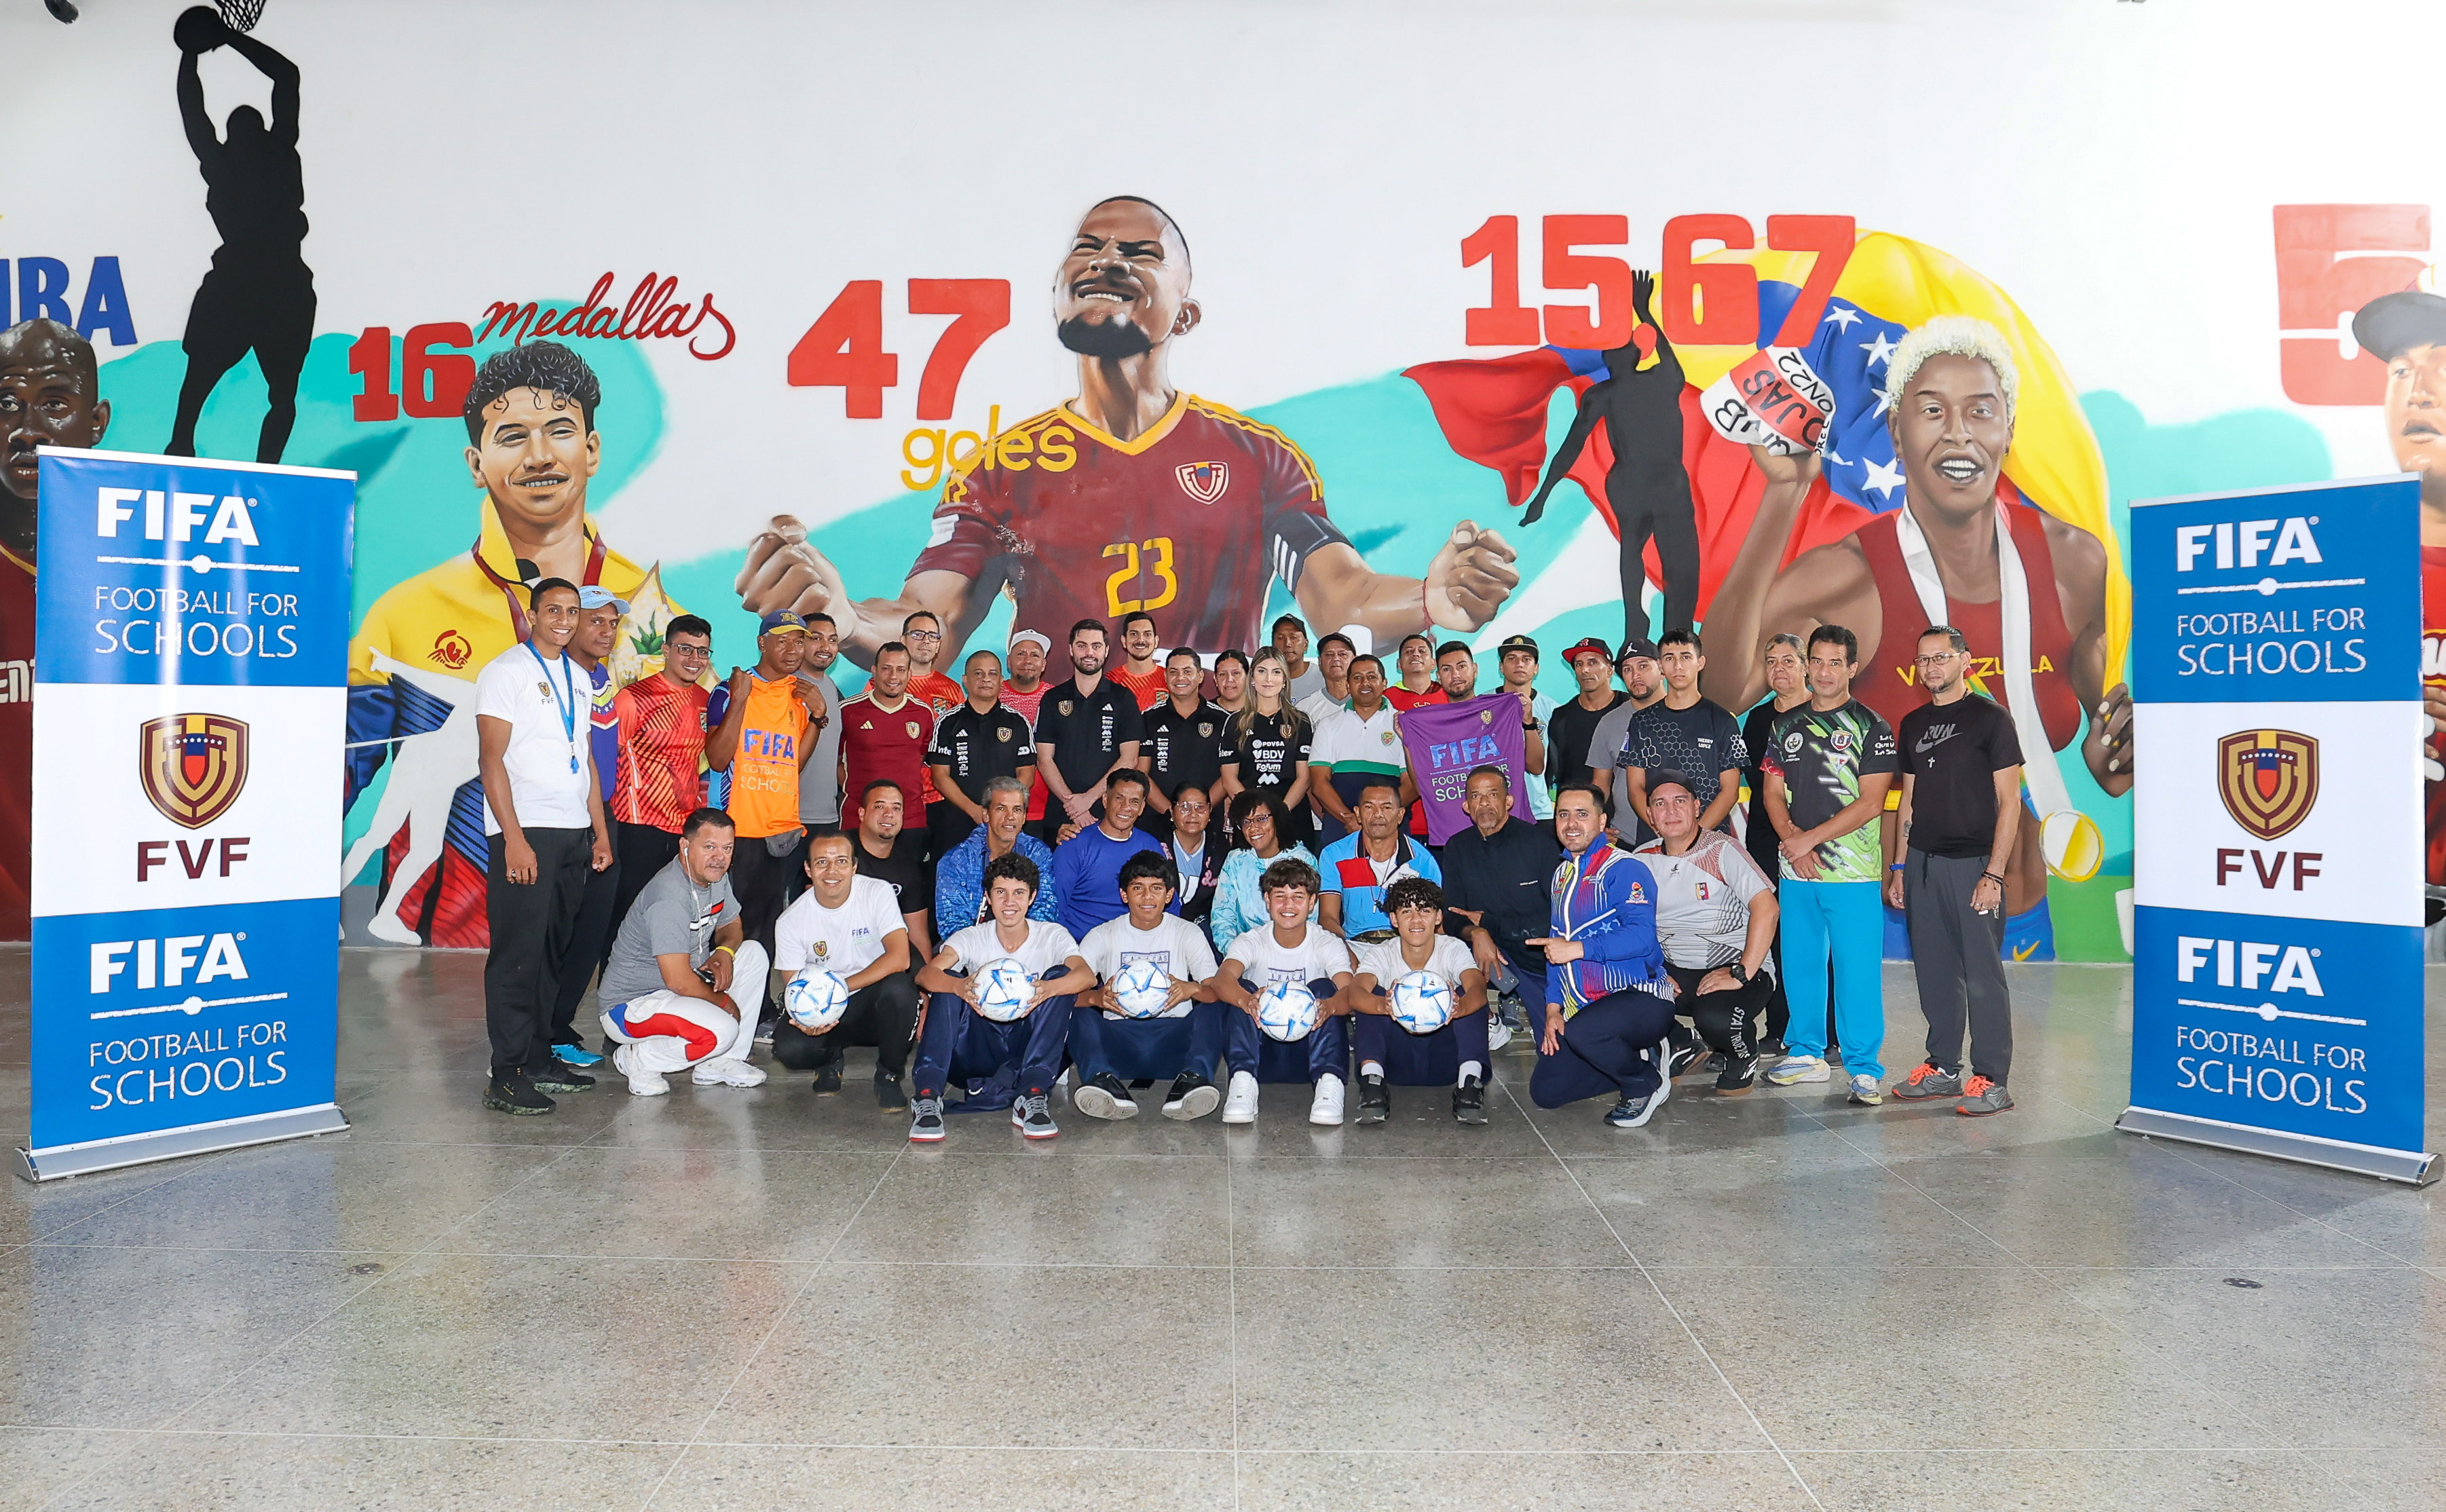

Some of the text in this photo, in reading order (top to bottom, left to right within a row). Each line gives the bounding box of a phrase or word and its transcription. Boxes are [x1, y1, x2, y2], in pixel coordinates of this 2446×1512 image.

[0, 256, 138, 346] BA
[348, 271, 736, 422] 16 medallas
[787, 278, 1011, 420] 47
[900, 404, 1078, 491] goles
[1102, 536, 1178, 618] 23
[96, 586, 299, 617] FOOTBALL FOR
[2177, 607, 2366, 637] FOOTBALL FOR
[95, 618, 298, 658] SCHOOLS
[2177, 638, 2367, 676] SCHOOLS
[743, 728, 795, 760] FIFA
[1923, 723, 1956, 740] RUN
[1256, 763, 1281, 772] Forum
[1262, 750, 1285, 759] BDV
[137, 837, 250, 882] FVF
[2217, 848, 2323, 891] FVF
[852, 927, 870, 937] FIFA
[815, 955, 831, 964] FVF
[90, 1020, 288, 1067] FOOTBALL FOR
[2177, 1025, 2367, 1072] FOOTBALL FOR
[90, 1051, 287, 1111] SCHOOLS
[2177, 1056, 2367, 1114] SCHOOLS
